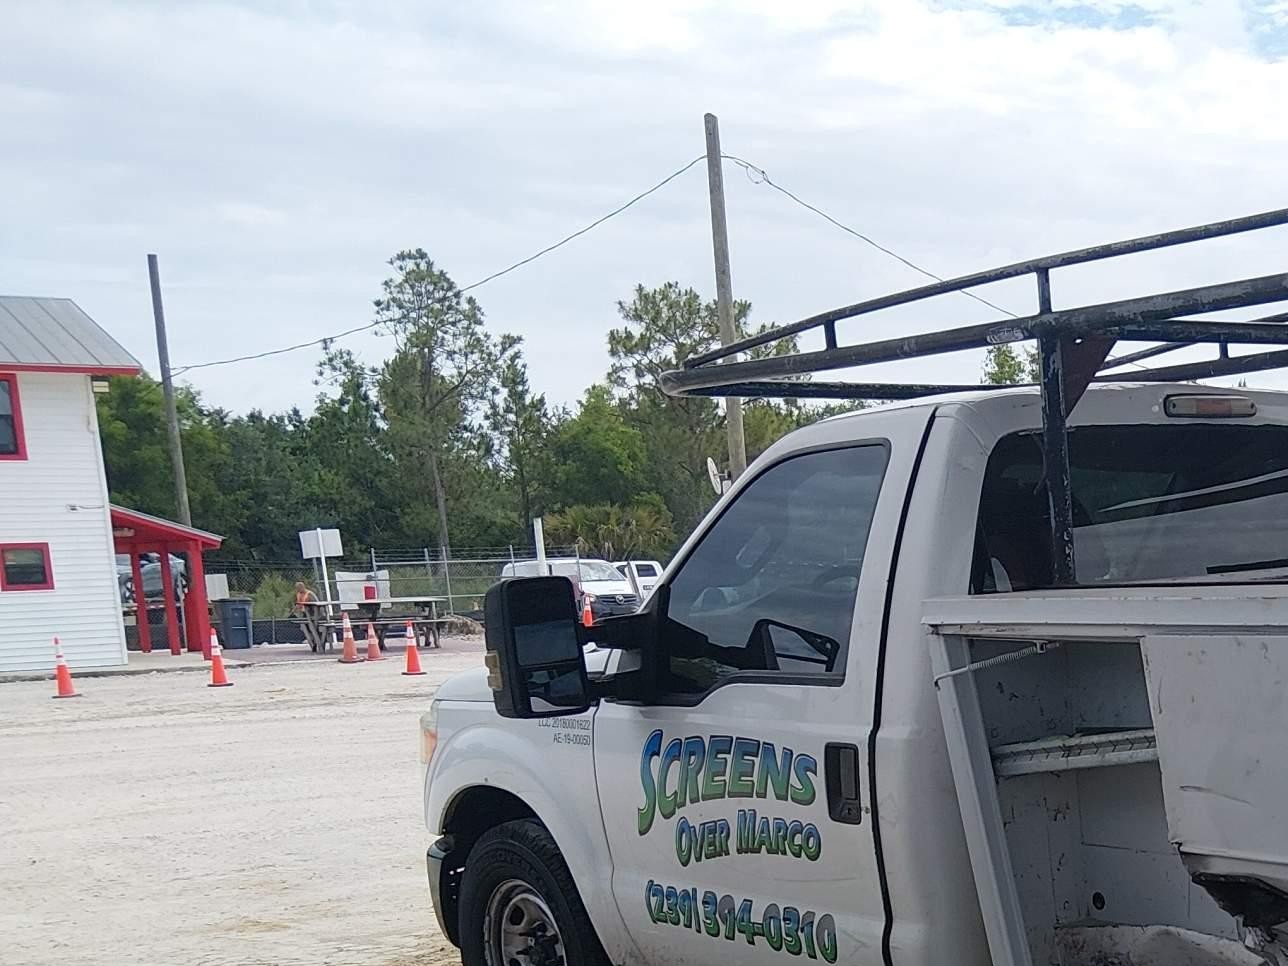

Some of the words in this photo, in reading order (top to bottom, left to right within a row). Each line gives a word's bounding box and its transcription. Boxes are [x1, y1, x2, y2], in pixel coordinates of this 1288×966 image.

[637, 729, 818, 836] SCREENS
[675, 816, 731, 866] OVER
[736, 809, 822, 861] MARCO
[645, 879, 702, 934] (239)
[702, 891, 838, 964] 394-0310
